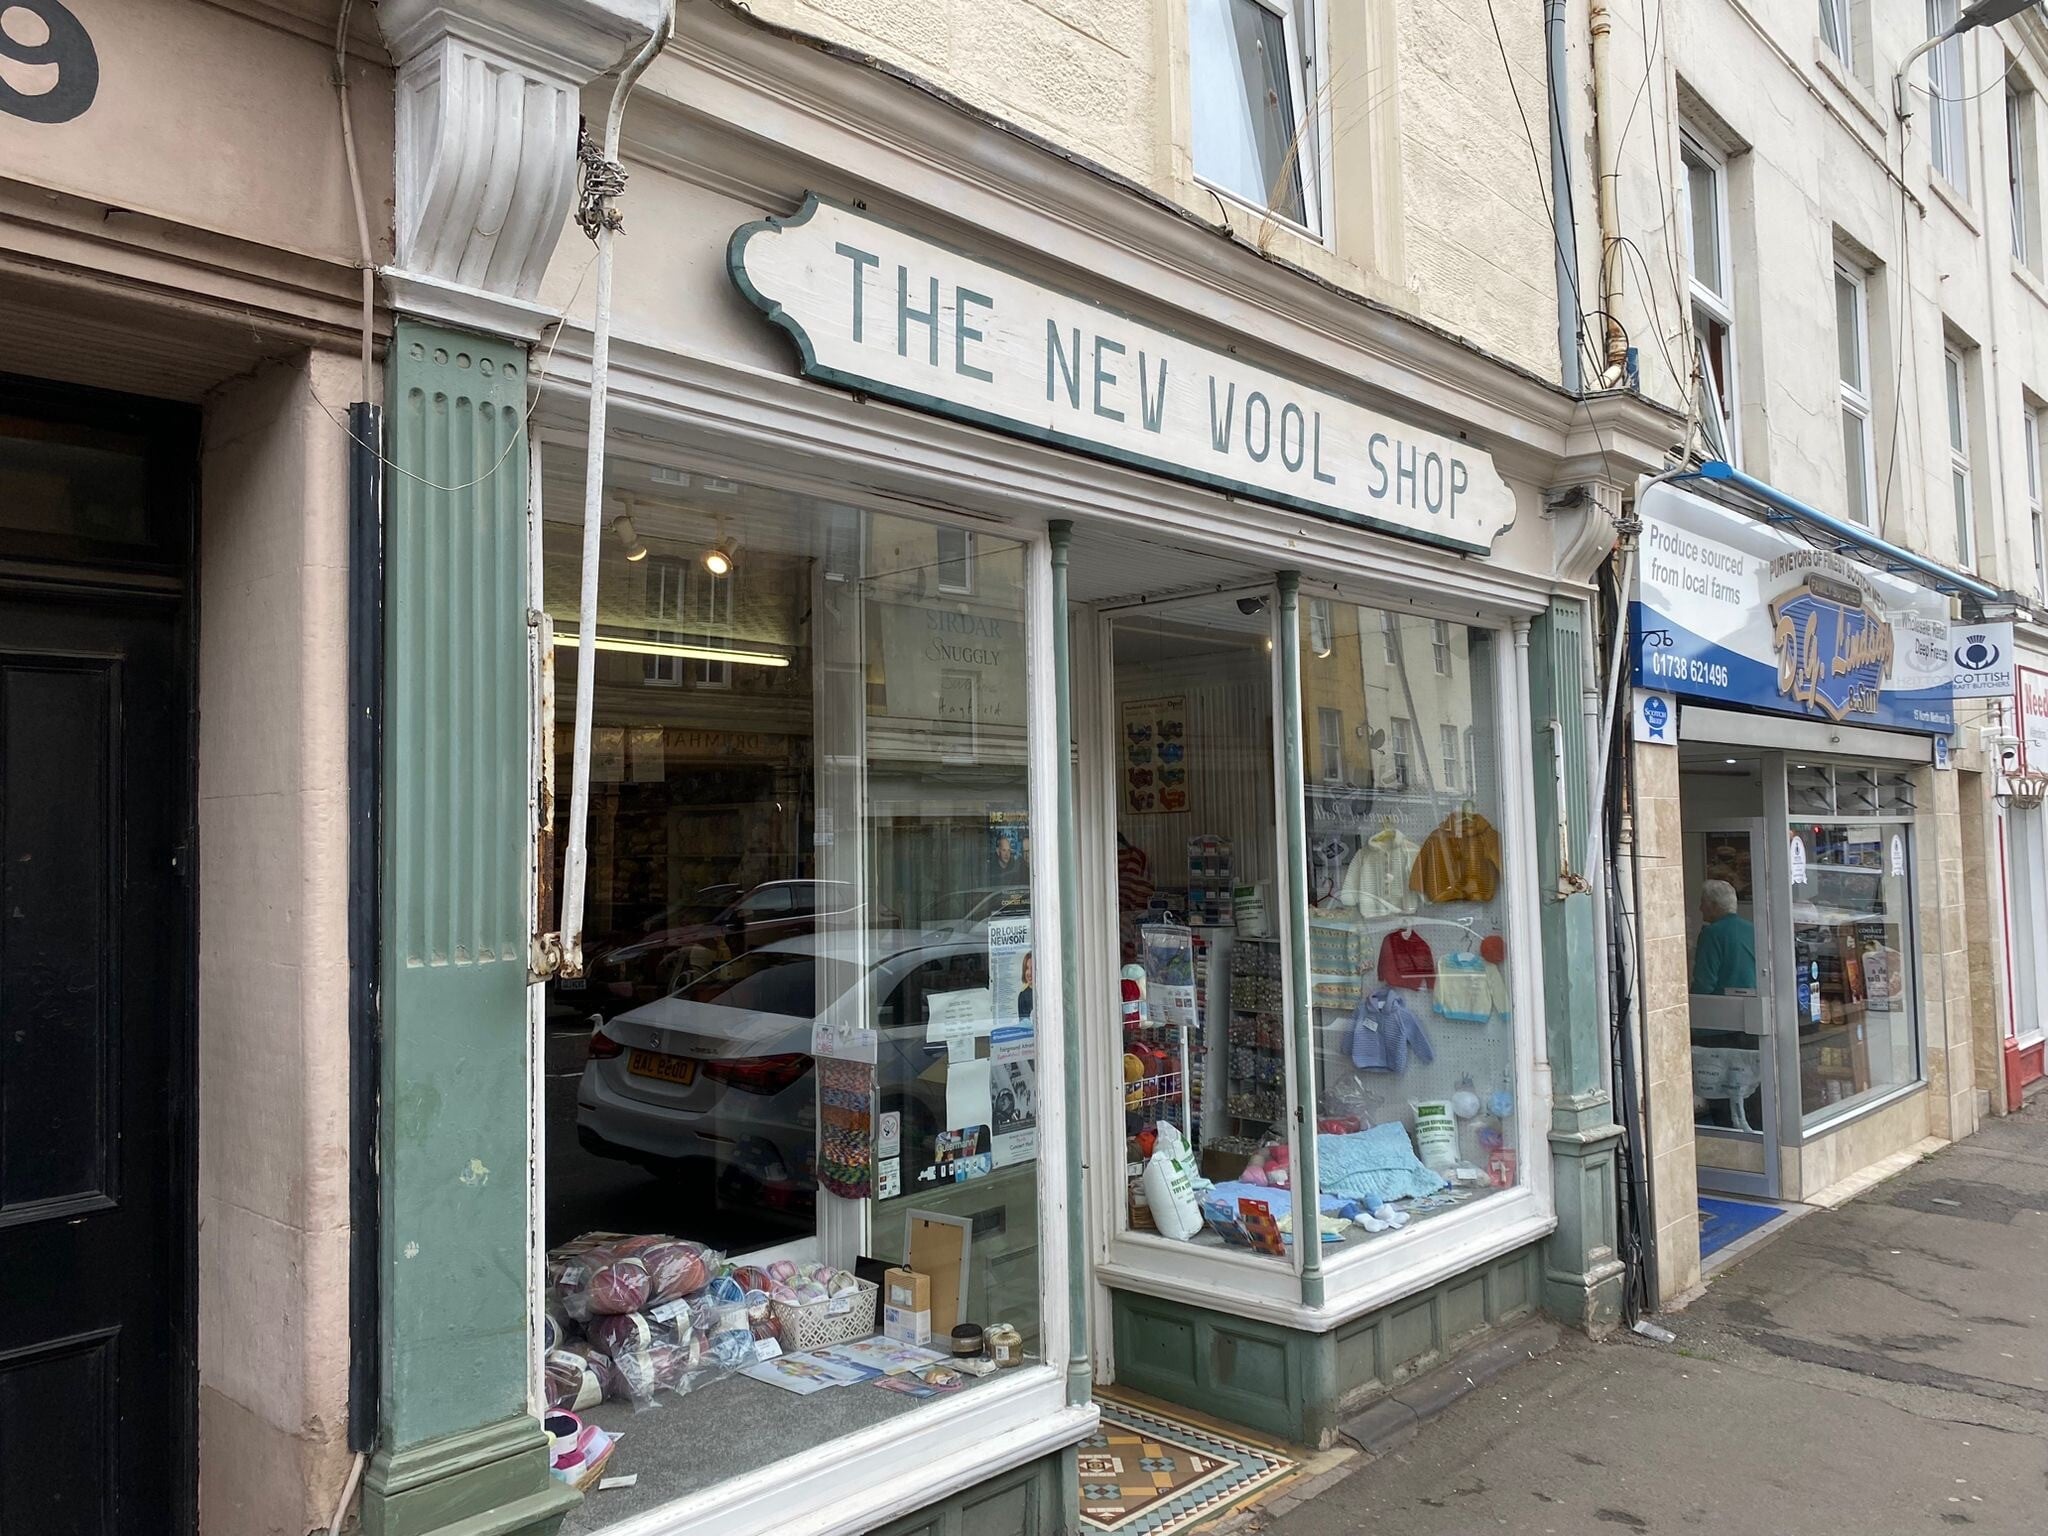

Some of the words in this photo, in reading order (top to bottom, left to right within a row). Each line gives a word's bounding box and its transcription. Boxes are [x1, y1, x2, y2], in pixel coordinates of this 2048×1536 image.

[835, 241, 994, 383] THE
[1046, 318, 1168, 435] NEW
[1208, 375, 1337, 485] WOOL
[1367, 432, 1469, 521] SHOP
[1650, 524, 1699, 561] Produce
[1701, 547, 1744, 577] sourced
[1769, 549, 1812, 582] PURVEYORS
[1813, 550, 1824, 568] OF
[1823, 551, 1846, 577] FINEST
[1652, 557, 1679, 588] from
[1682, 567, 1709, 596] local
[1711, 576, 1741, 605] farms
[926, 608, 1001, 639] SIRDAR
[925, 636, 1000, 667] SNUGGLY
[1914, 638, 1929, 661] Deep
[1930, 643, 1948, 662] Freeze
[1652, 652, 1688, 681] 01738
[1690, 660, 1728, 687] 621496
[1954, 671, 2010, 685] COTTISH
[1973, 681, 2010, 690] BUTCHERS
[1645, 707, 1667, 719] SCOTCH
[991, 926, 1001, 938] DR
[1001, 925, 1027, 937] LOUISE
[991, 935, 1025, 947] NEWSON
